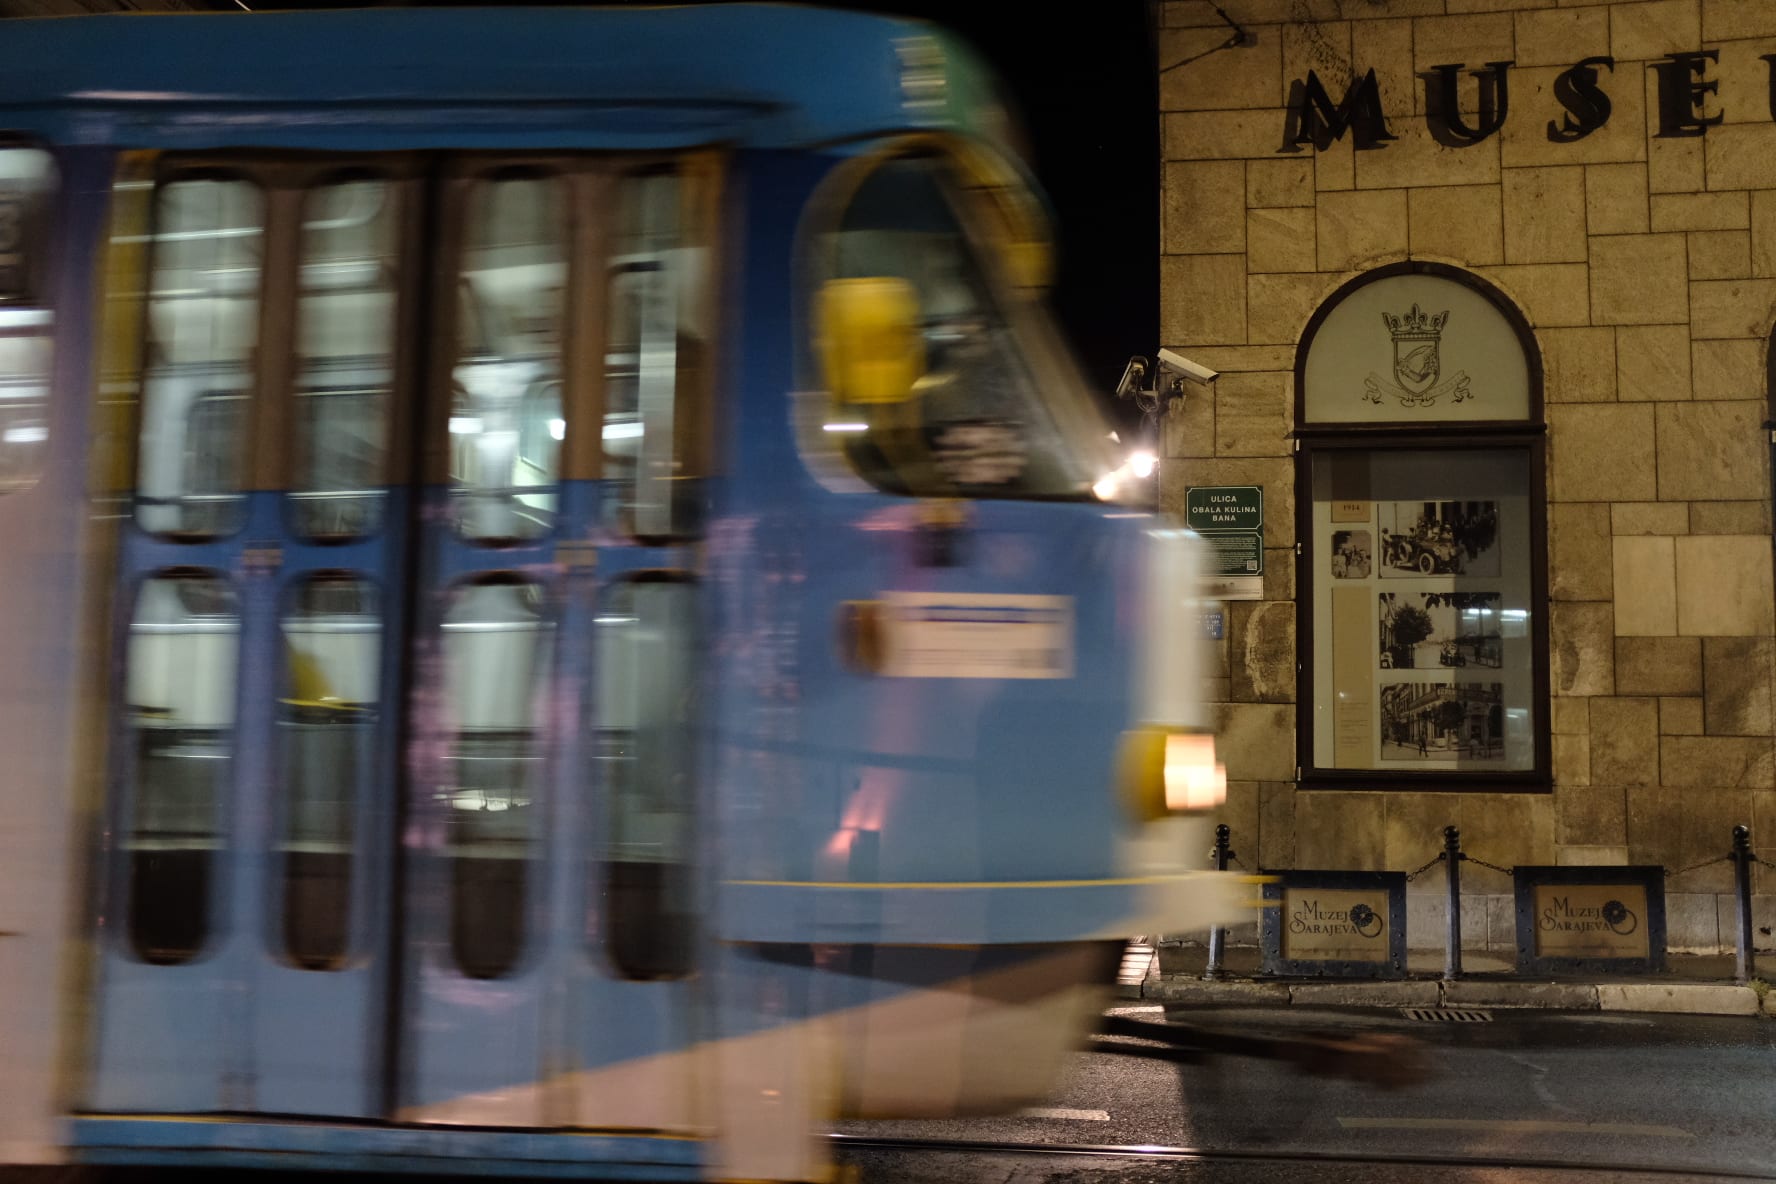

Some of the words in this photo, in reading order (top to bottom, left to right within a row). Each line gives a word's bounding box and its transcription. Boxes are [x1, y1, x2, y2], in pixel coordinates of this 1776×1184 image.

[1288, 47, 1776, 147] MUSE
[1210, 495, 1237, 503] ULICA
[1192, 506, 1221, 514] OBALA
[1212, 514, 1236, 522] BANA
